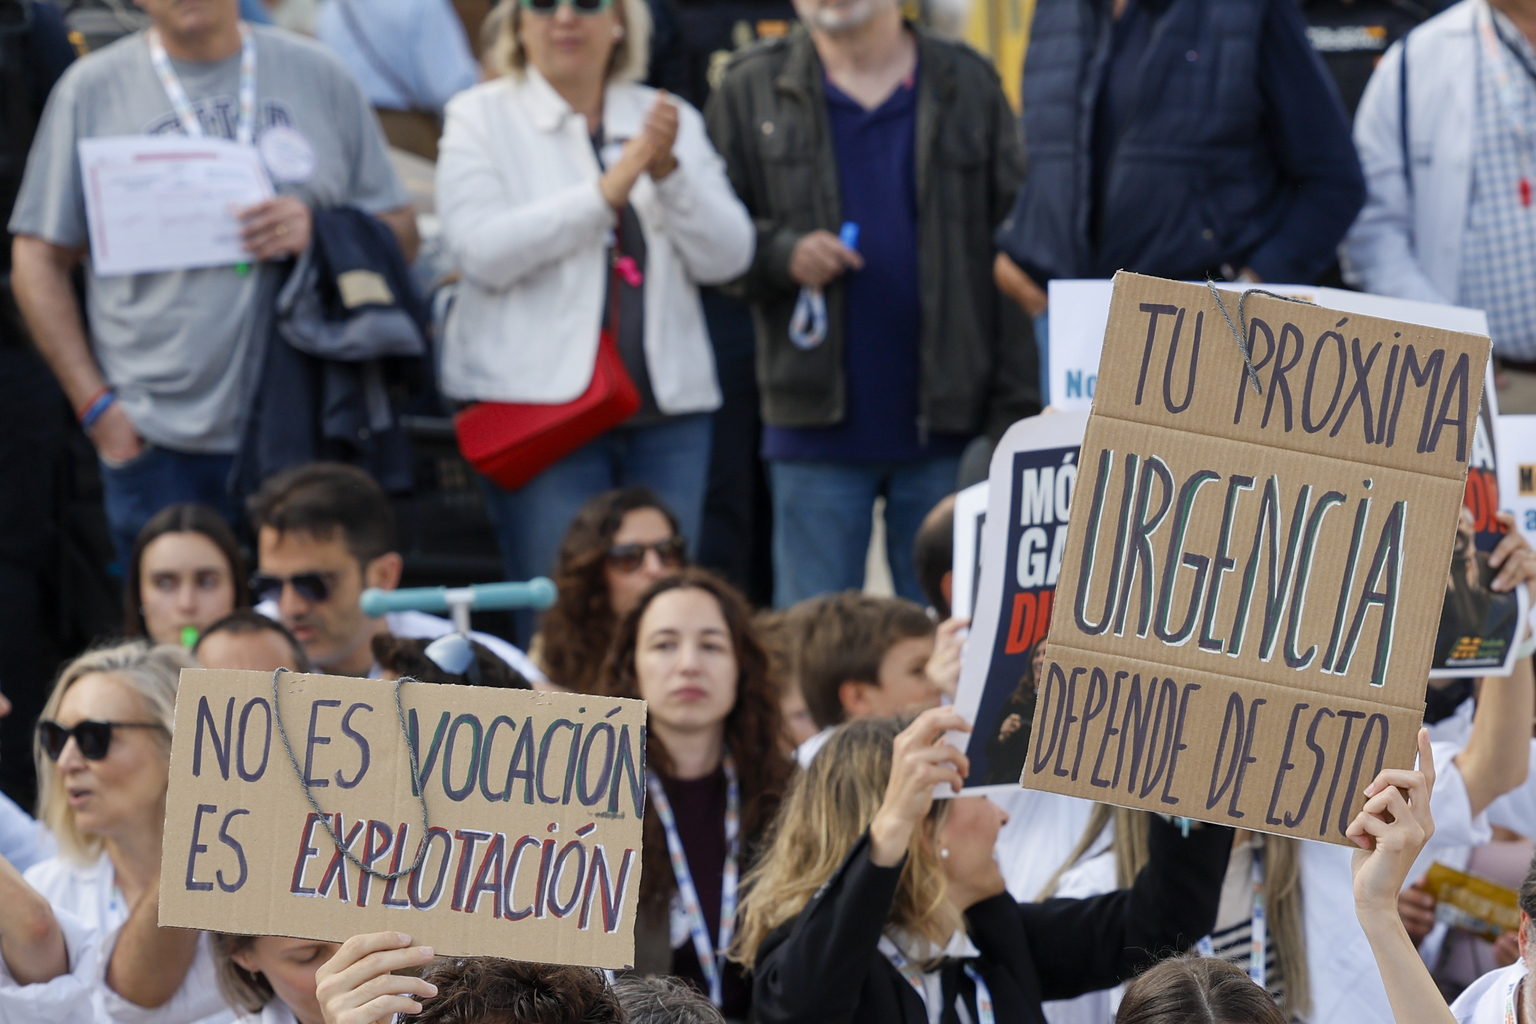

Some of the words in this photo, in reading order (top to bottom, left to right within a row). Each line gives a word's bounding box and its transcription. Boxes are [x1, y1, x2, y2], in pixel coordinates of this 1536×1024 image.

[1134, 303, 1203, 414] TU
[1233, 317, 1469, 463] PRÓXIMA
[1074, 448, 1408, 688] URGENCIA
[192, 695, 272, 783] NO
[303, 700, 374, 790] ES
[409, 706, 647, 819] VOCACIÓN
[1033, 662, 1201, 805] DEPENDE
[1205, 691, 1267, 818] DE
[1265, 702, 1389, 836] ESTO
[186, 804, 250, 893] ES
[291, 812, 636, 934] EXPLOTACIÓN
